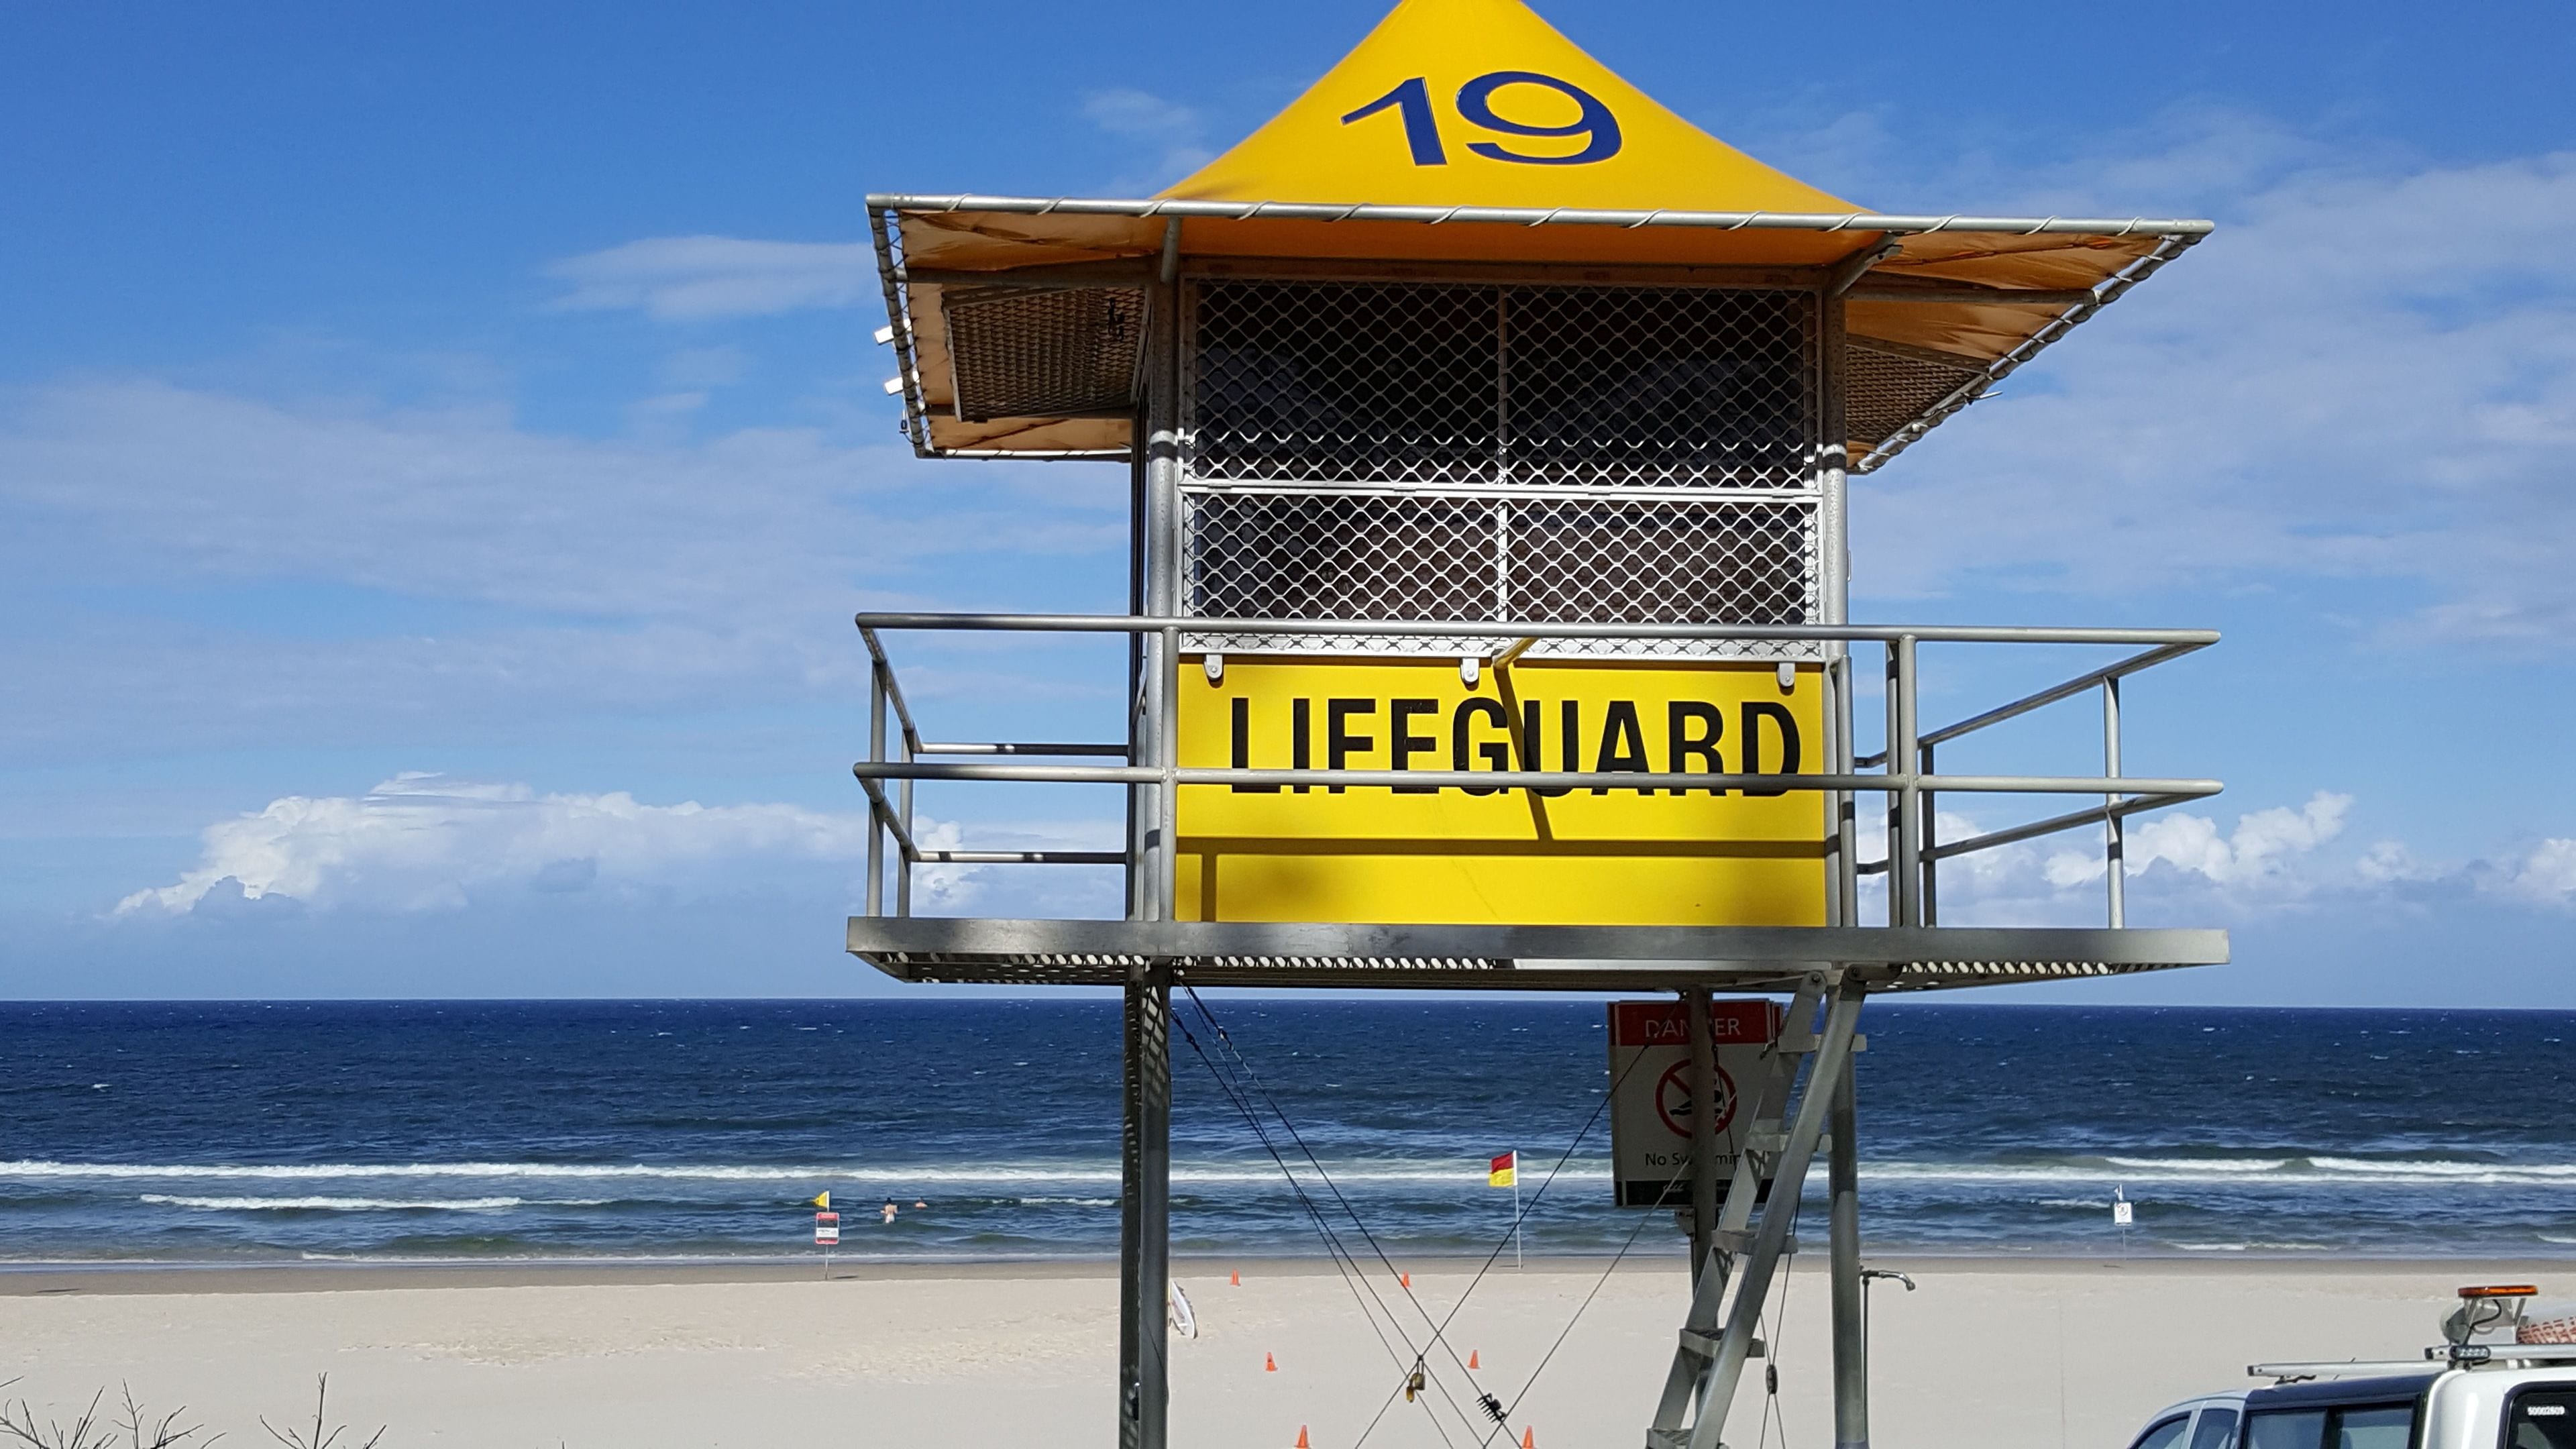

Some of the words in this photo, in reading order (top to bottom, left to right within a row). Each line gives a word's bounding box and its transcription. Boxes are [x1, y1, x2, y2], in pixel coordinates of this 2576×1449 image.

[1340, 70, 1623, 166] 19
[1230, 696, 1801, 798] LIFEGUARD
[1645, 1018, 1741, 1038] DANER
[1646, 1152, 1666, 1166] No
